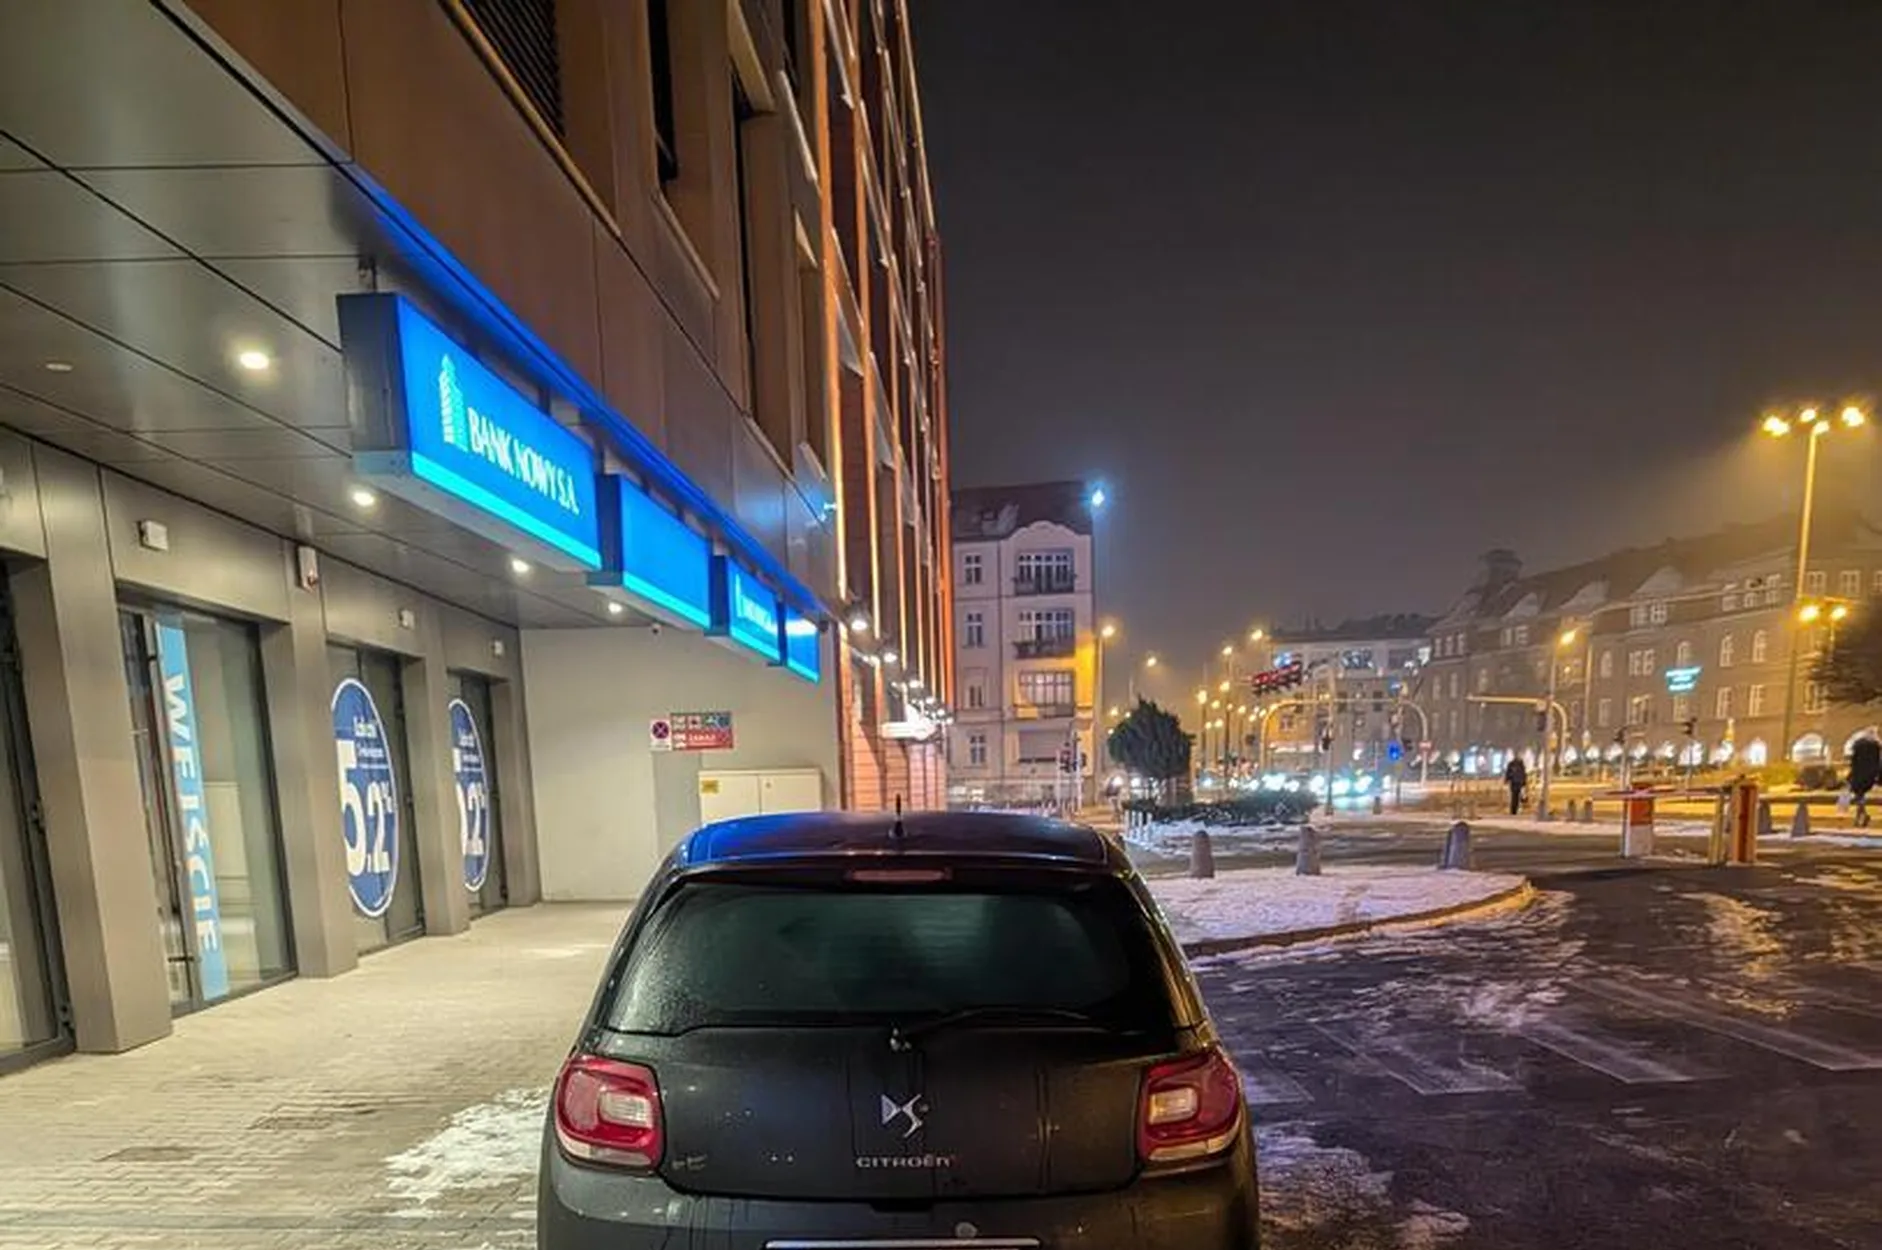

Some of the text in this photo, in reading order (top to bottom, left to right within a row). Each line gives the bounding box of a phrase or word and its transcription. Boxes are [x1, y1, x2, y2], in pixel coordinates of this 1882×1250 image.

[467, 406, 515, 476] BANK
[513, 437, 557, 500] NOWY
[855, 1153, 951, 1168] CITROËN
